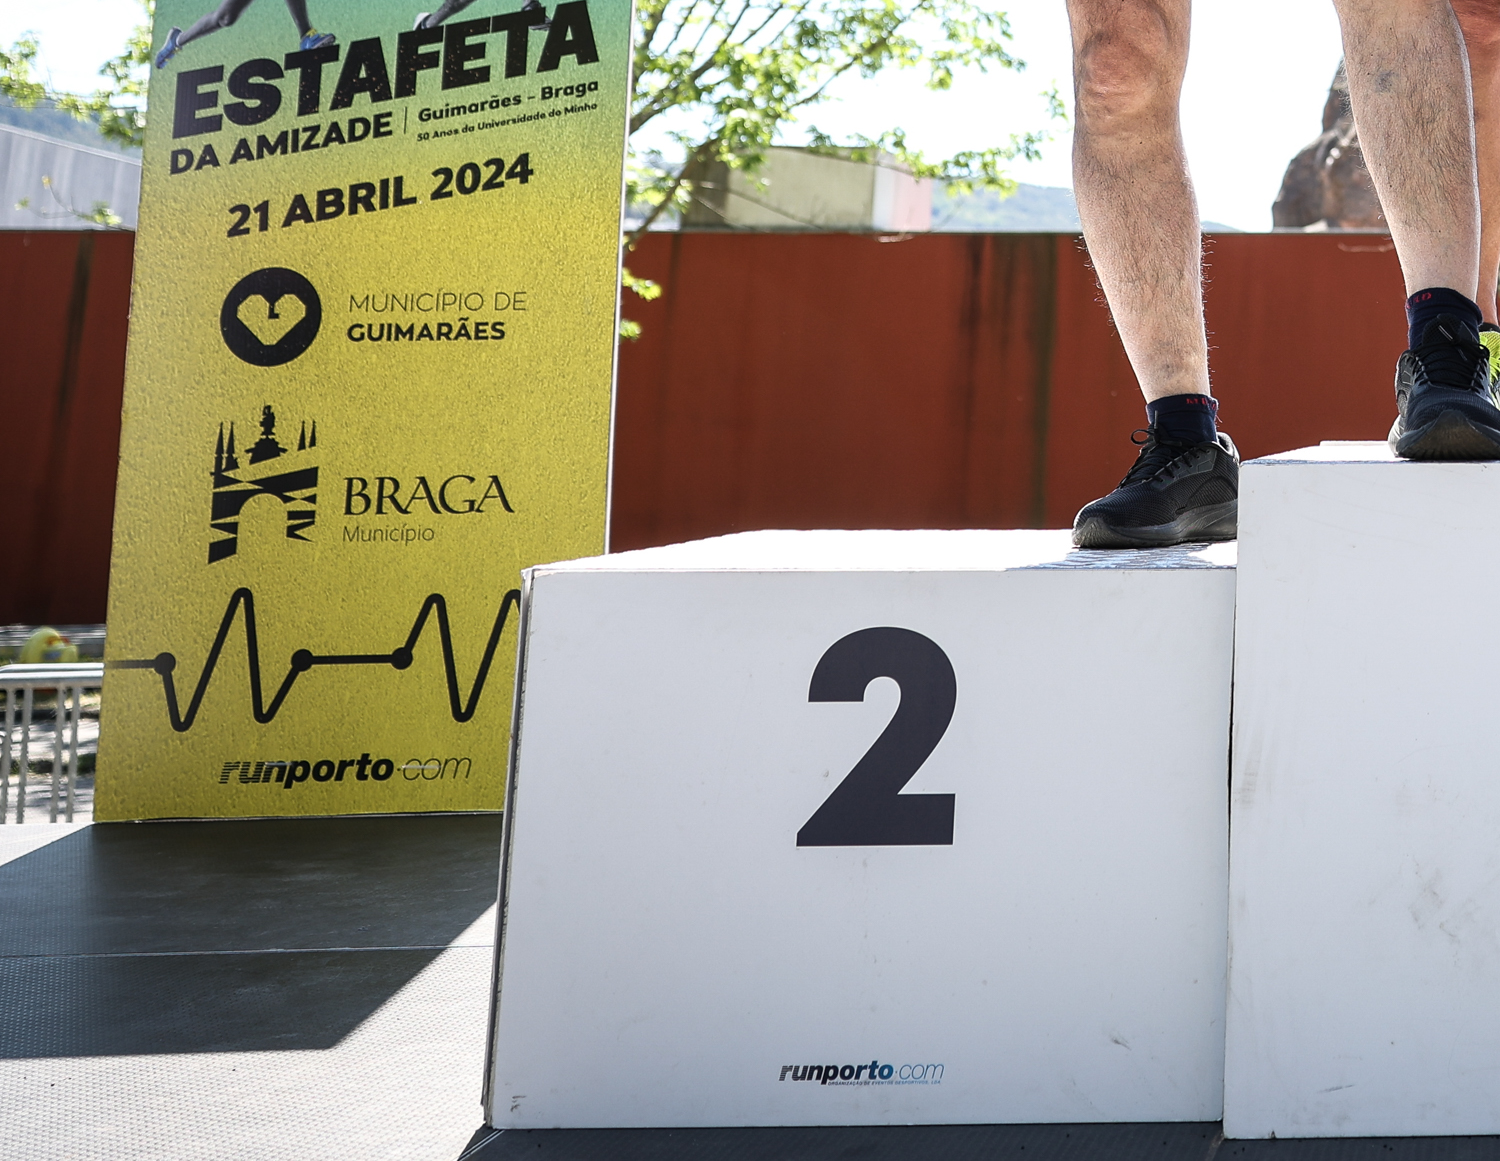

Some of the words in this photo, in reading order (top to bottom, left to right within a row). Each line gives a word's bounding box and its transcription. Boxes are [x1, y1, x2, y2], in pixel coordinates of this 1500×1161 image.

[172, 0, 599, 139] ESTAFETA
[417, 133, 430, 141] 50
[432, 128, 459, 139] Anos
[462, 125, 474, 133] da
[478, 111, 546, 131] Universidade
[548, 109, 562, 117] do
[564, 102, 598, 116] Minho
[418, 95, 522, 122] Guimarães
[541, 81, 599, 101] Braga
[170, 147, 220, 175] DA
[229, 111, 393, 165] AMIZADE
[226, 199, 269, 238] 21
[282, 175, 417, 228] ABRIL
[430, 153, 534, 201] 2024
[349, 287, 485, 314] MUNICÍPIO
[494, 291, 527, 312] DE
[346, 317, 506, 343] GUIMARÃES
[343, 475, 515, 517] BRAGA
[343, 524, 435, 547] Município
[796, 626, 957, 847] 2
